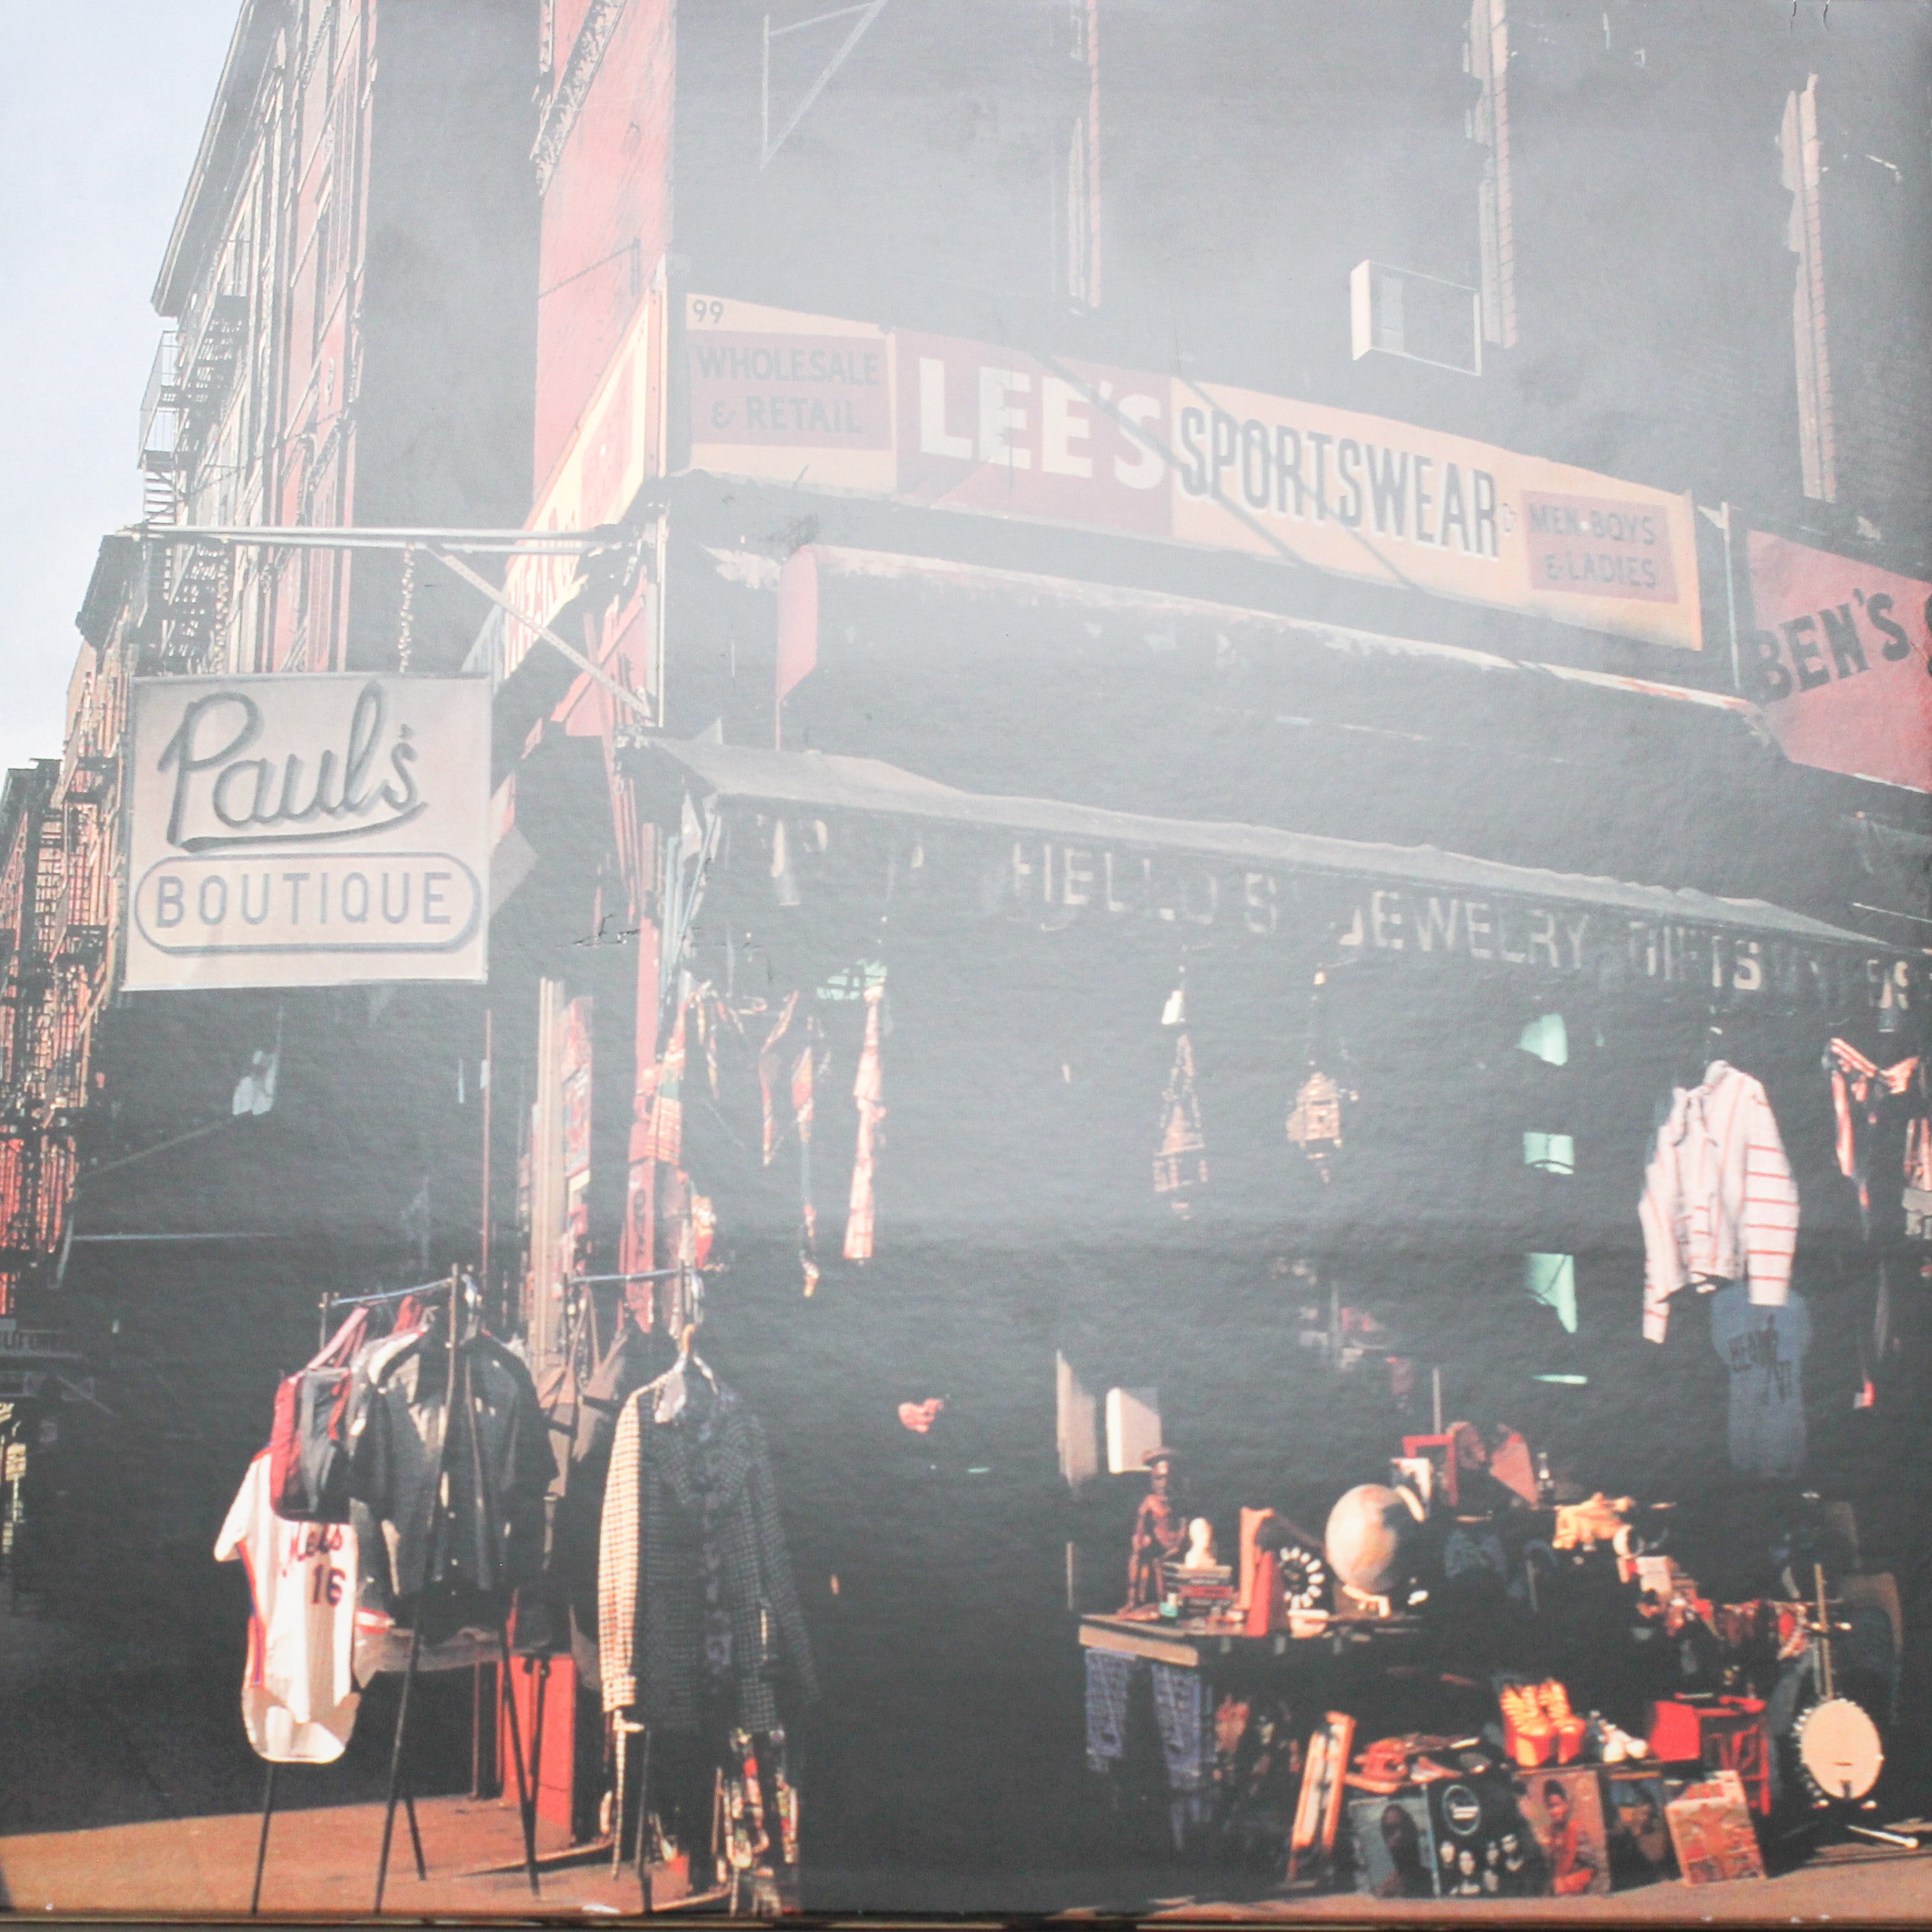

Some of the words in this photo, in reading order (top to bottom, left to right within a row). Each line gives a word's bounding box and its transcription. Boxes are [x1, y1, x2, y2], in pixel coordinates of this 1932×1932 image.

[692, 299, 725, 324] 99
[696, 345, 880, 387] WHOLESALE
[711, 400, 736, 430] &
[747, 396, 862, 434] RETAIL
[919, 357, 1166, 491] LEE'S
[1180, 406, 1499, 559] SPORTSWEAR
[1751, 588, 1911, 707] BEN'S
[157, 678, 429, 853] Paul's
[155, 871, 452, 928] BOUTIQUE
[311, 1564, 346, 1606] 16
